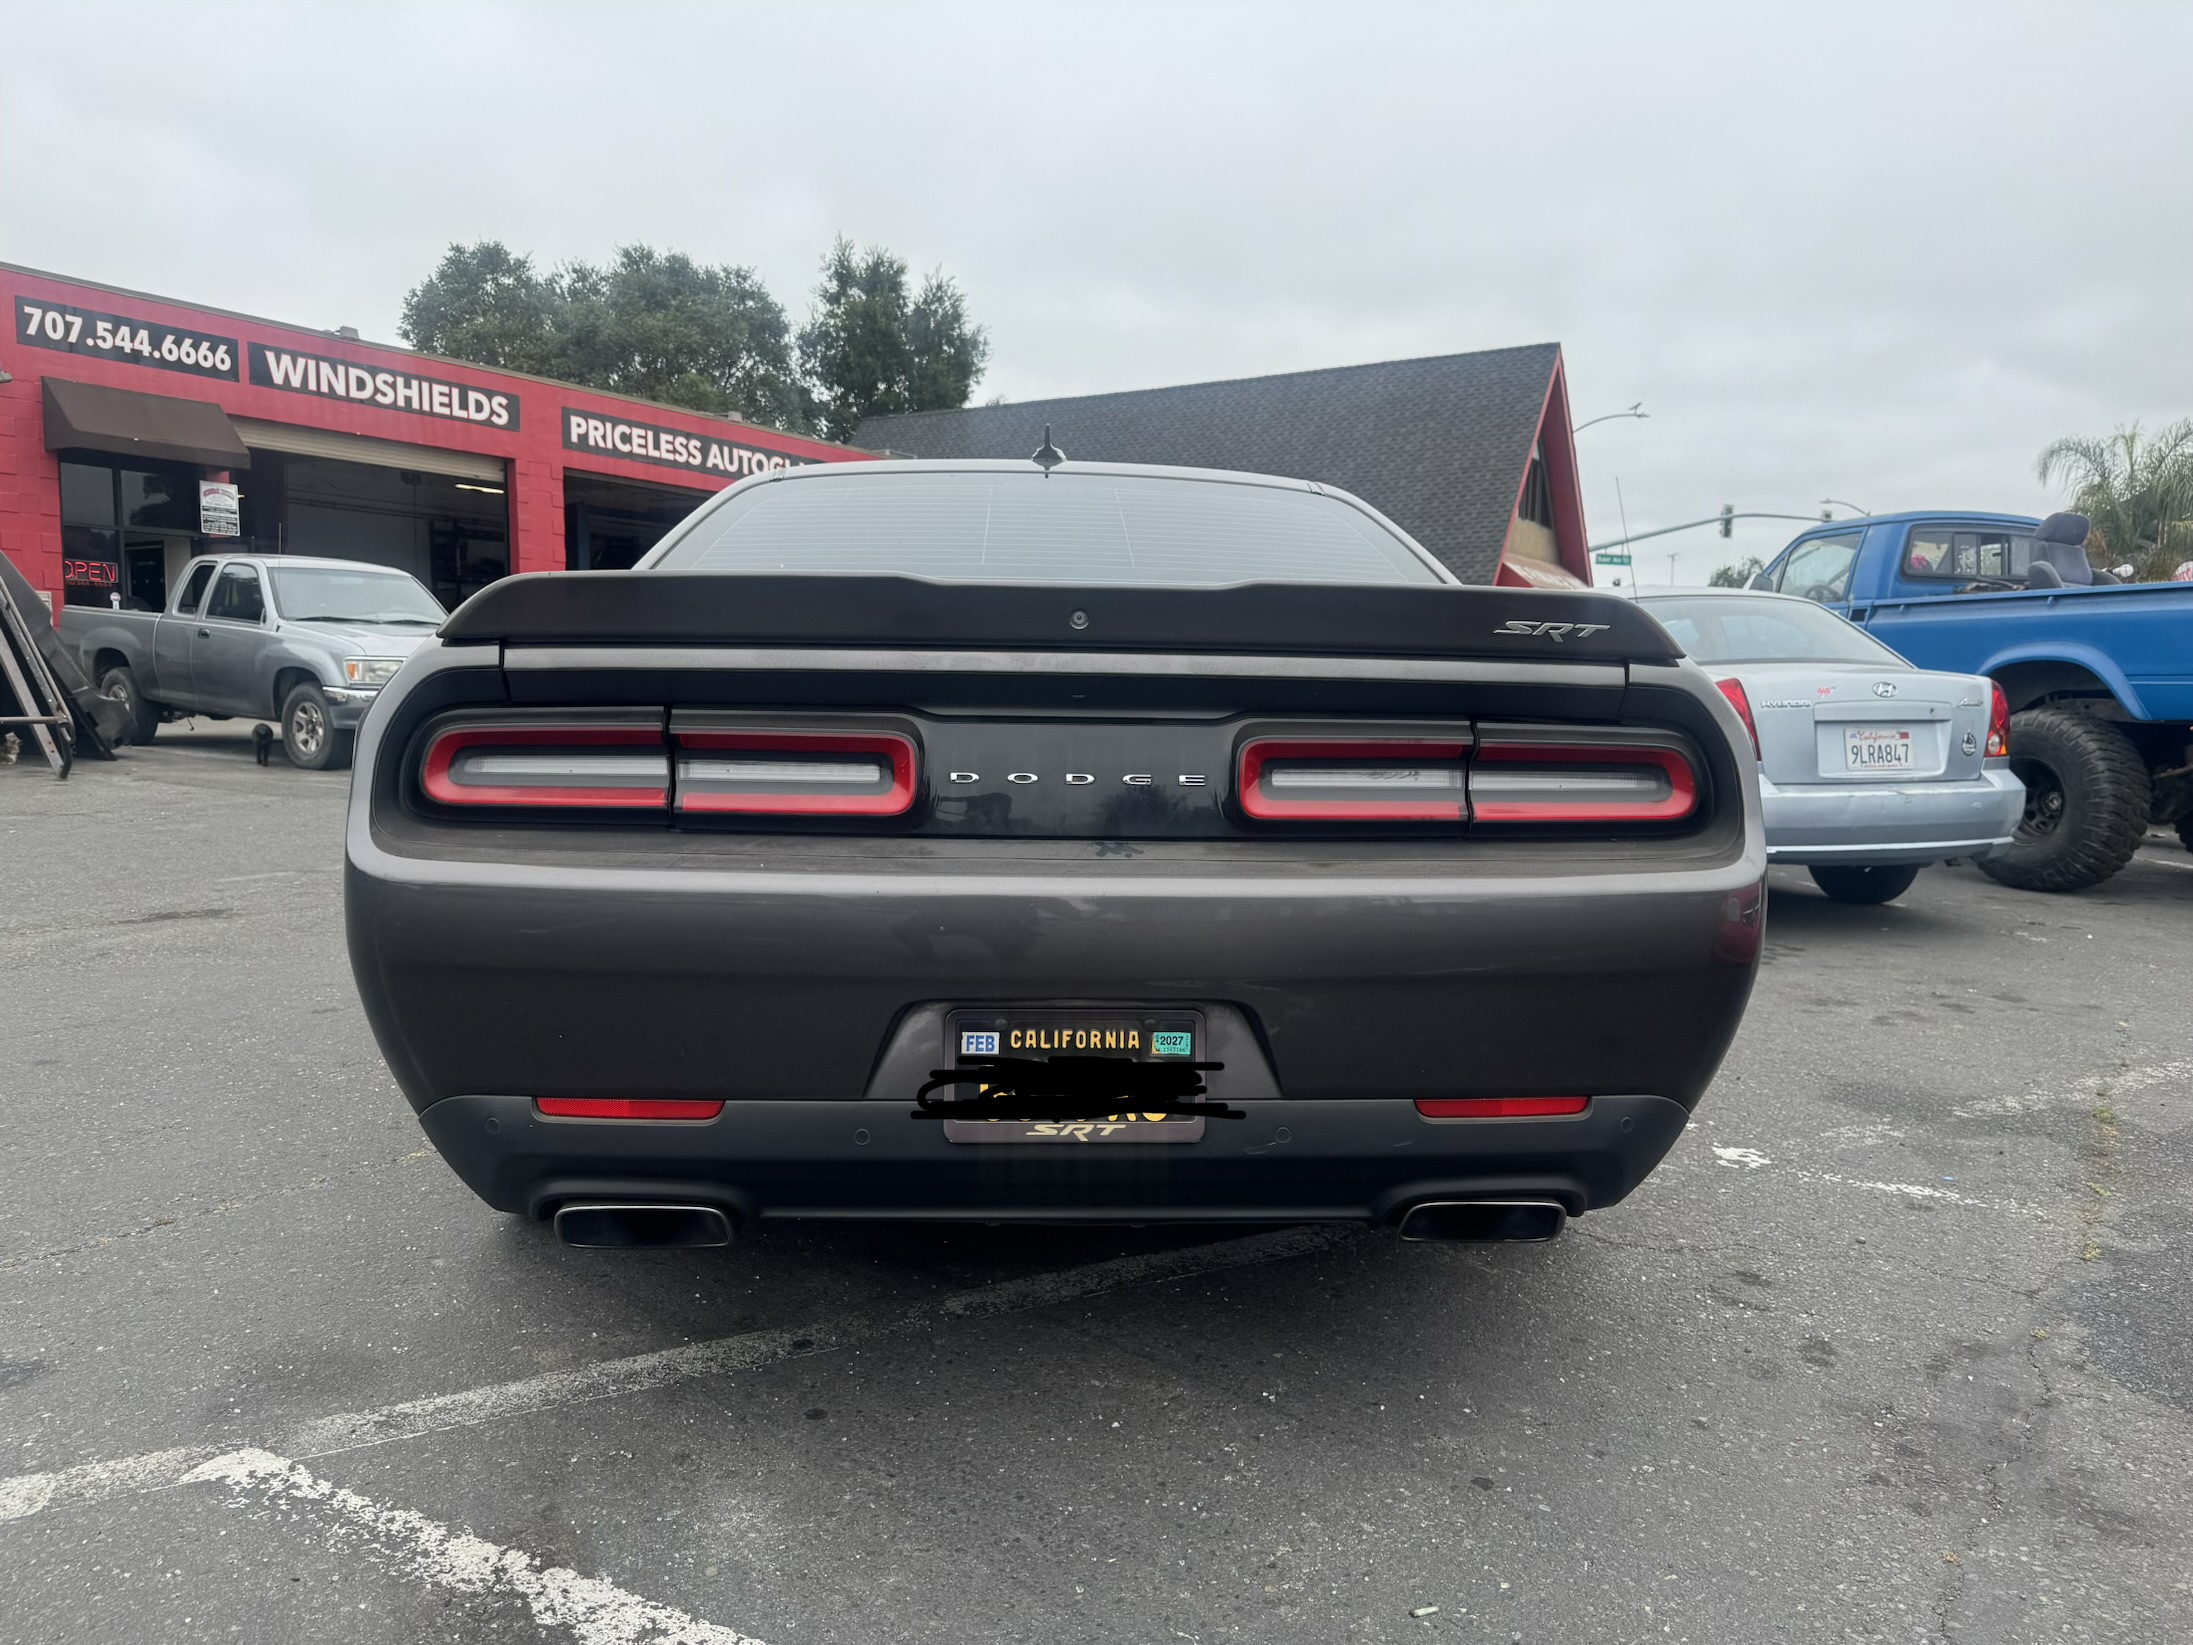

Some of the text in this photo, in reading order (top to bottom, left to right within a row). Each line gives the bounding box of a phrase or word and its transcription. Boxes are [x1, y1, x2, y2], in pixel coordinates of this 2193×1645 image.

[24, 306, 232, 372] 707.544.6666
[264, 351, 510, 426] WINDSHIELDS
[570, 416, 806, 479] PRICELESS AUTOG
[1493, 621, 1611, 642] SRT
[1851, 744, 1909, 764] 9LRA847
[950, 772, 1206, 786] DODGE
[966, 1035, 996, 1053] FEB
[1010, 1031, 1140, 1050] CALIFORNIA
[1160, 1036, 1184, 1046] 2027
[1025, 1124, 1127, 1142] SRT
